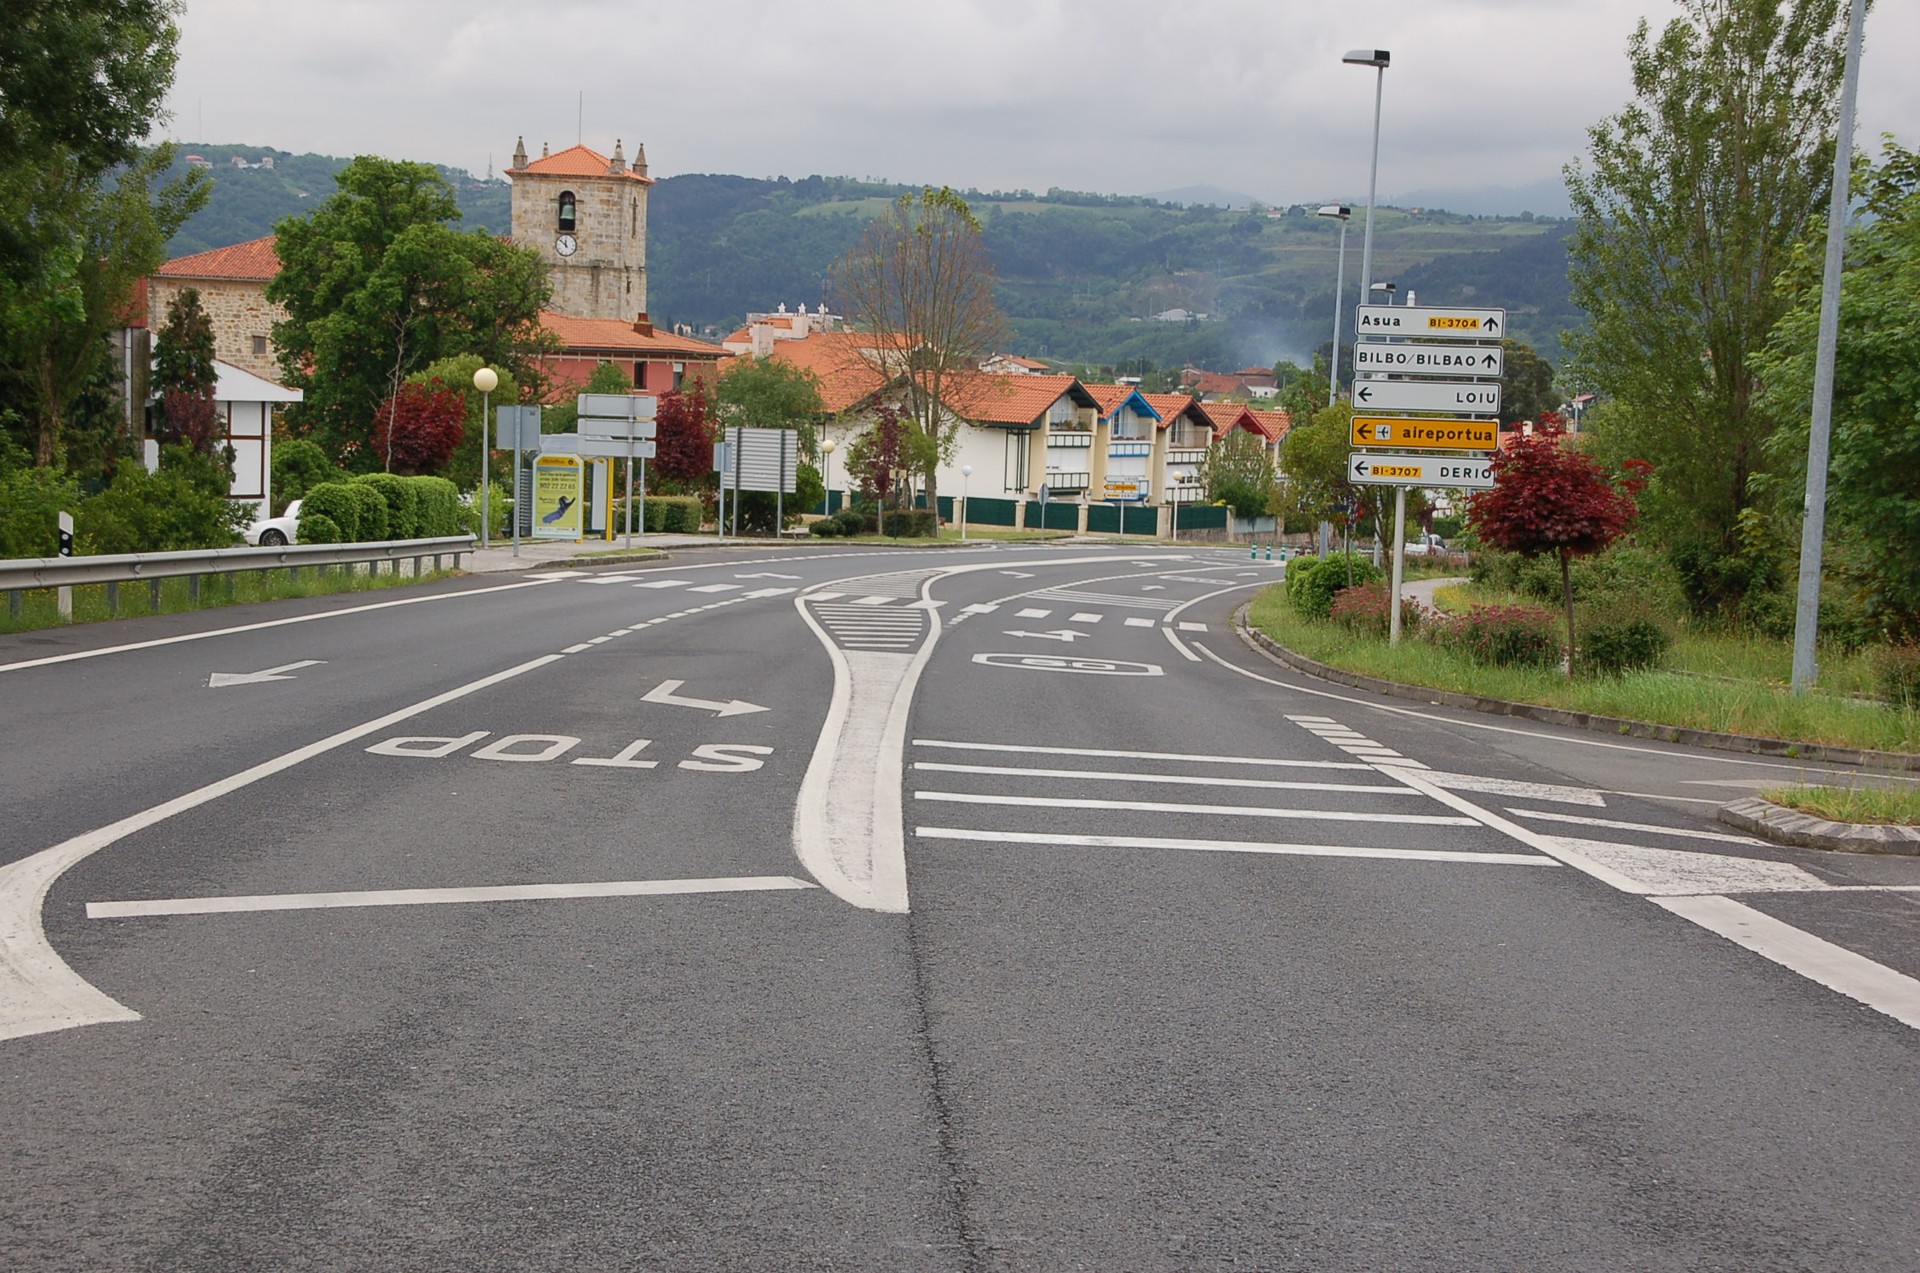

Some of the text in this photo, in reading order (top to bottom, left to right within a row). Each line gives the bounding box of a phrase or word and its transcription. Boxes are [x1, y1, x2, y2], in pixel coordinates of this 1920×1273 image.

[1361, 315, 1478, 328] Asua BI-3704
[1358, 352, 1476, 367] BILBO/BILBAO
[1456, 392, 1496, 404] LOIU
[1402, 426, 1493, 442] aireportua
[1372, 467, 1492, 478] BI-3707 DERIO
[364, 730, 775, 773] STOP
